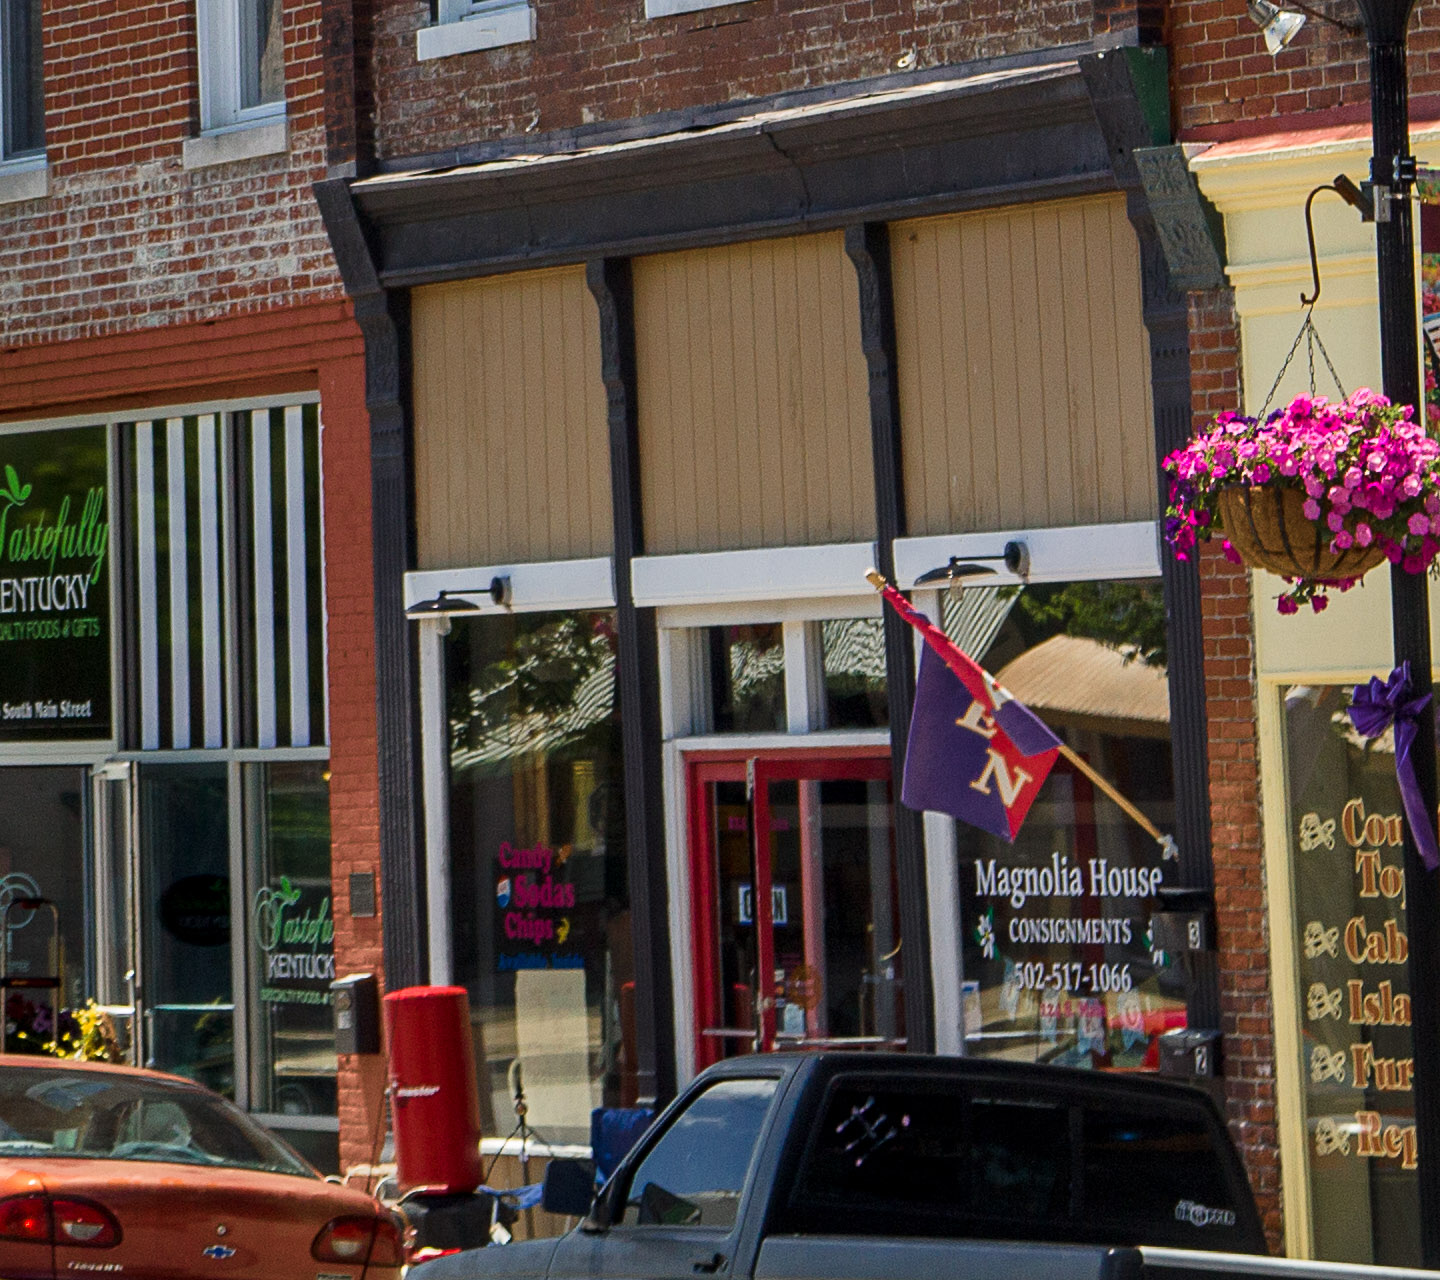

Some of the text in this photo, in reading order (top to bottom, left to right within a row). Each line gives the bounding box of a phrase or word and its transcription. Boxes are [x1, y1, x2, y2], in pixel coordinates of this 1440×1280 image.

[26, 620, 60, 640] FOODS
[71, 617, 101, 638] GIFTS
[2, 701, 33, 720] South
[34, 700, 59, 719] Main
[60, 699, 92, 718] Street
[499, 840, 553, 875] Candy
[514, 875, 576, 908] Sodas
[974, 850, 1164, 909] Magnolia House
[256, 876, 335, 952] Tastefu
[505, 911, 553, 946] Chips
[1008, 916, 1132, 945] CONSIGNMENTS
[269, 953, 335, 980] KENTUCK
[1016, 961, 1132, 993] 502-517-1066
